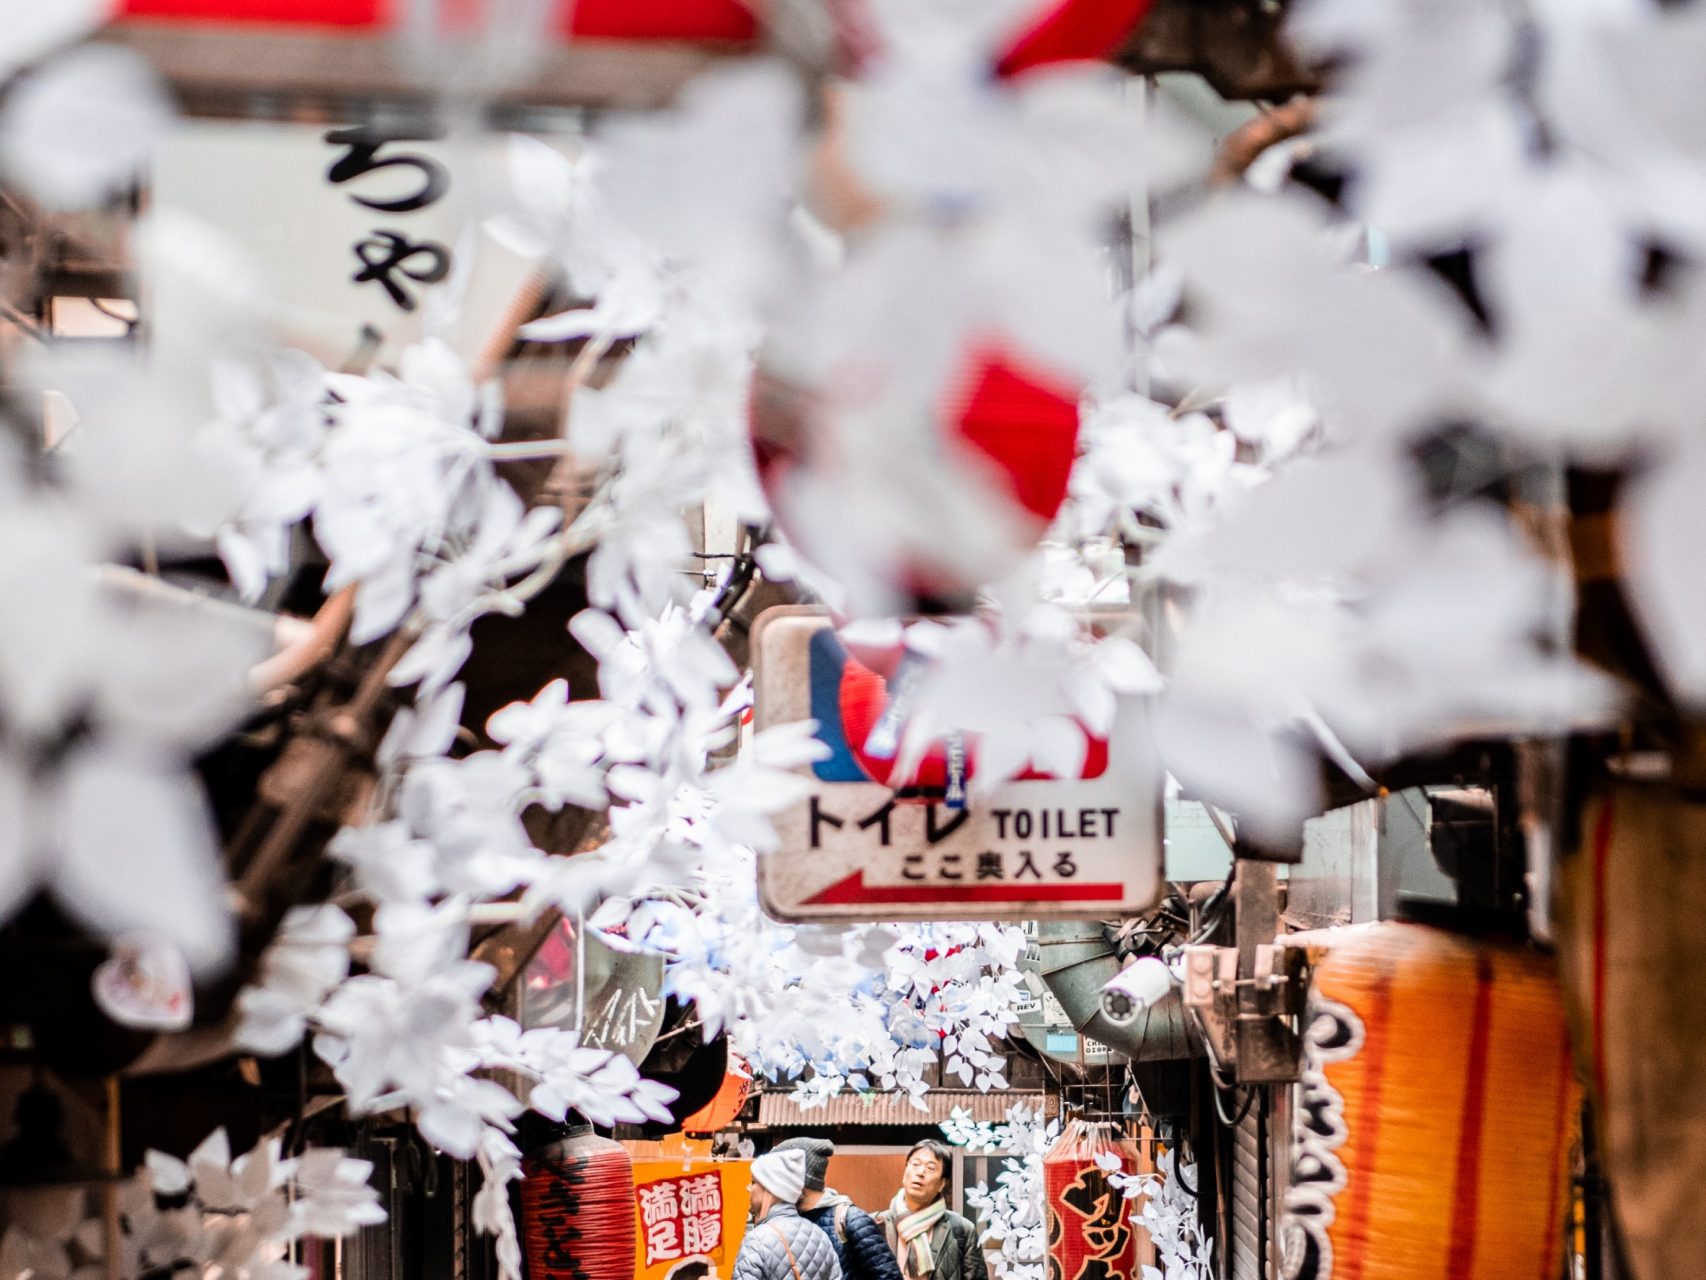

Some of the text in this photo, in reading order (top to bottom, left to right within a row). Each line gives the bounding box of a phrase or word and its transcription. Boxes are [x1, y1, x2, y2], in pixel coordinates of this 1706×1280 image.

[810, 794, 1120, 849] トイレ TOILET
[901, 850, 1078, 881] ここ奥入る
[639, 1181, 682, 1266] 満足
[679, 1174, 722, 1255] 満腹
